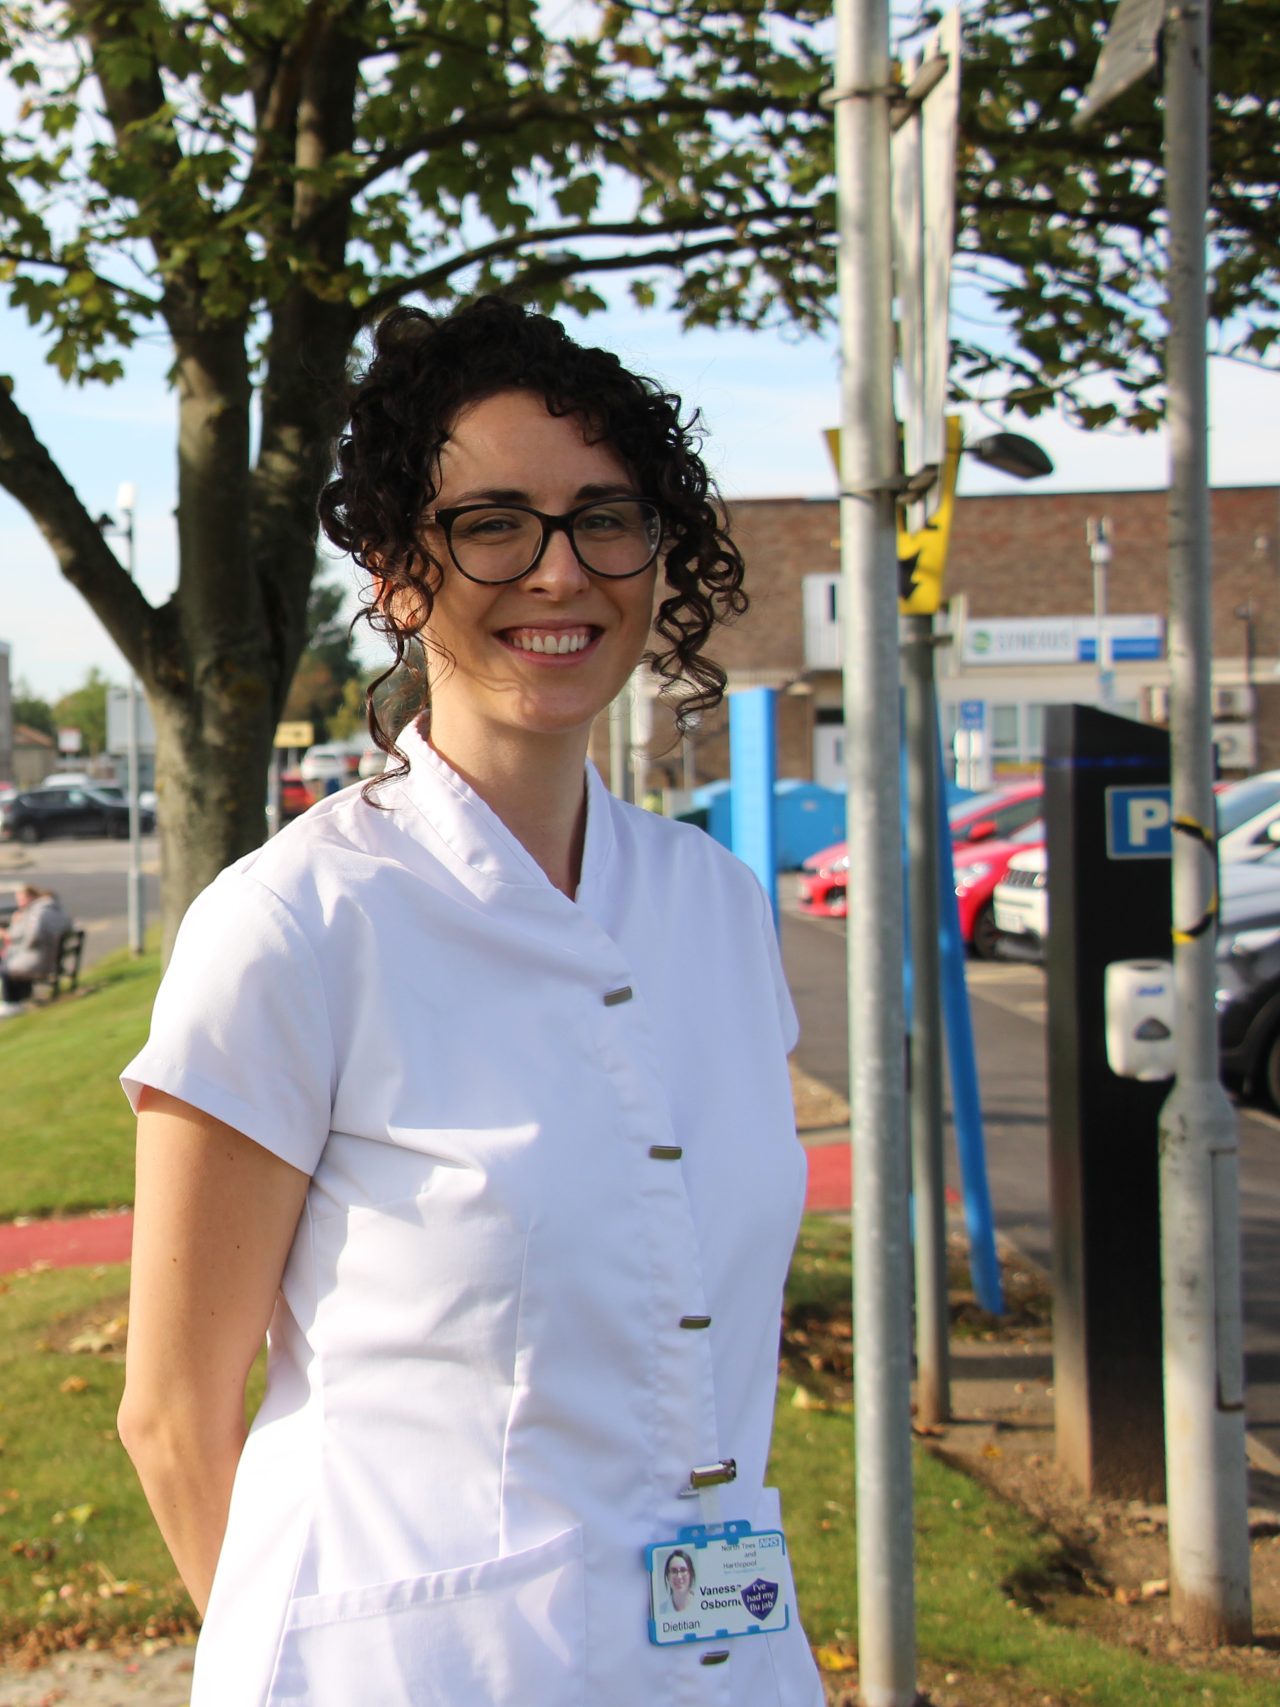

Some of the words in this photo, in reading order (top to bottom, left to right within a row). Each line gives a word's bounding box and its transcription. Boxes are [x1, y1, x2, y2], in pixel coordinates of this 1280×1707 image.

[1127, 798, 1172, 847] P
[760, 1538, 779, 1547] NHS
[723, 1560, 757, 1569] Hartlepool
[752, 1583, 766, 1592] I've
[746, 1593, 761, 1602] had
[762, 1591, 774, 1600] my
[749, 1603, 761, 1612] flu
[761, 1601, 773, 1611] jab
[662, 1620, 701, 1633] Dietitian
